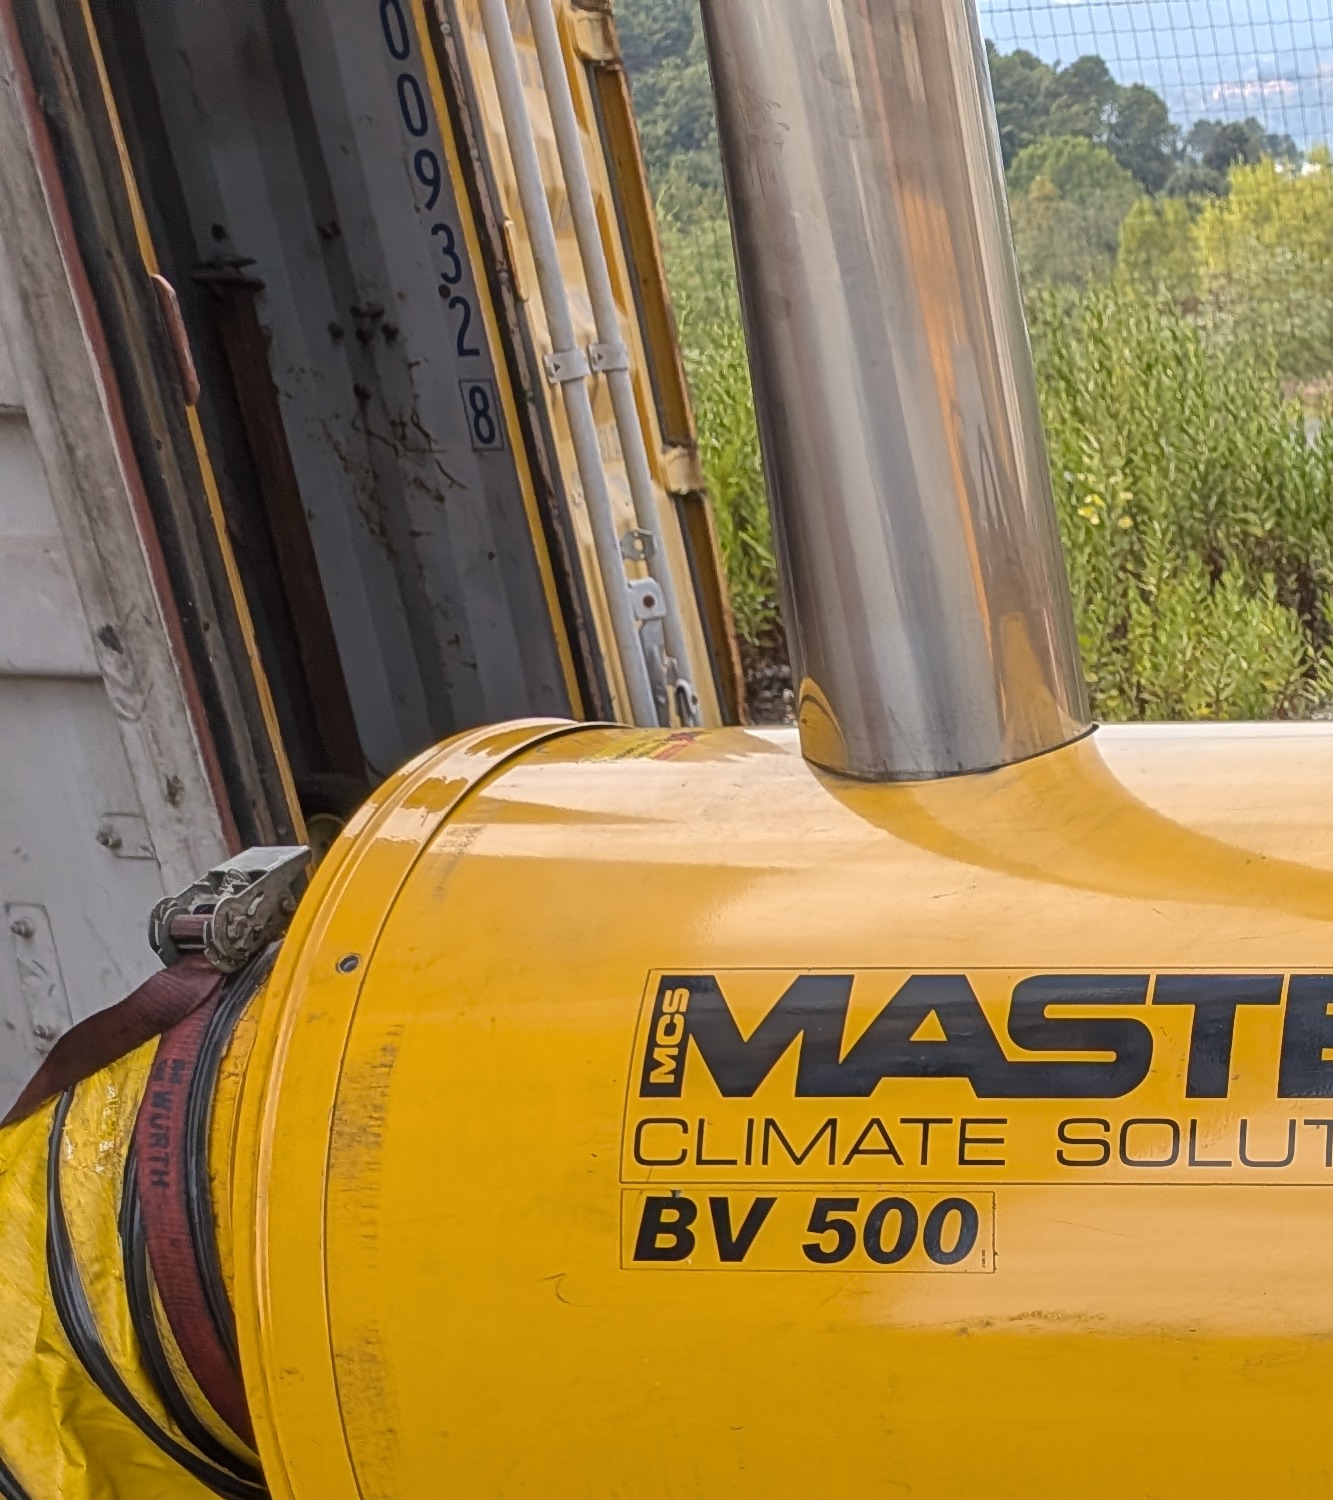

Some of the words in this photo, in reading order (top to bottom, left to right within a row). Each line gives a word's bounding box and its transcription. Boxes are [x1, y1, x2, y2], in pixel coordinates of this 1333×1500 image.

[649, 988, 690, 1083] MCS
[633, 1117, 1008, 1167] CLIMATE
[633, 1196, 778, 1263] BV
[802, 1196, 979, 1266] 500
